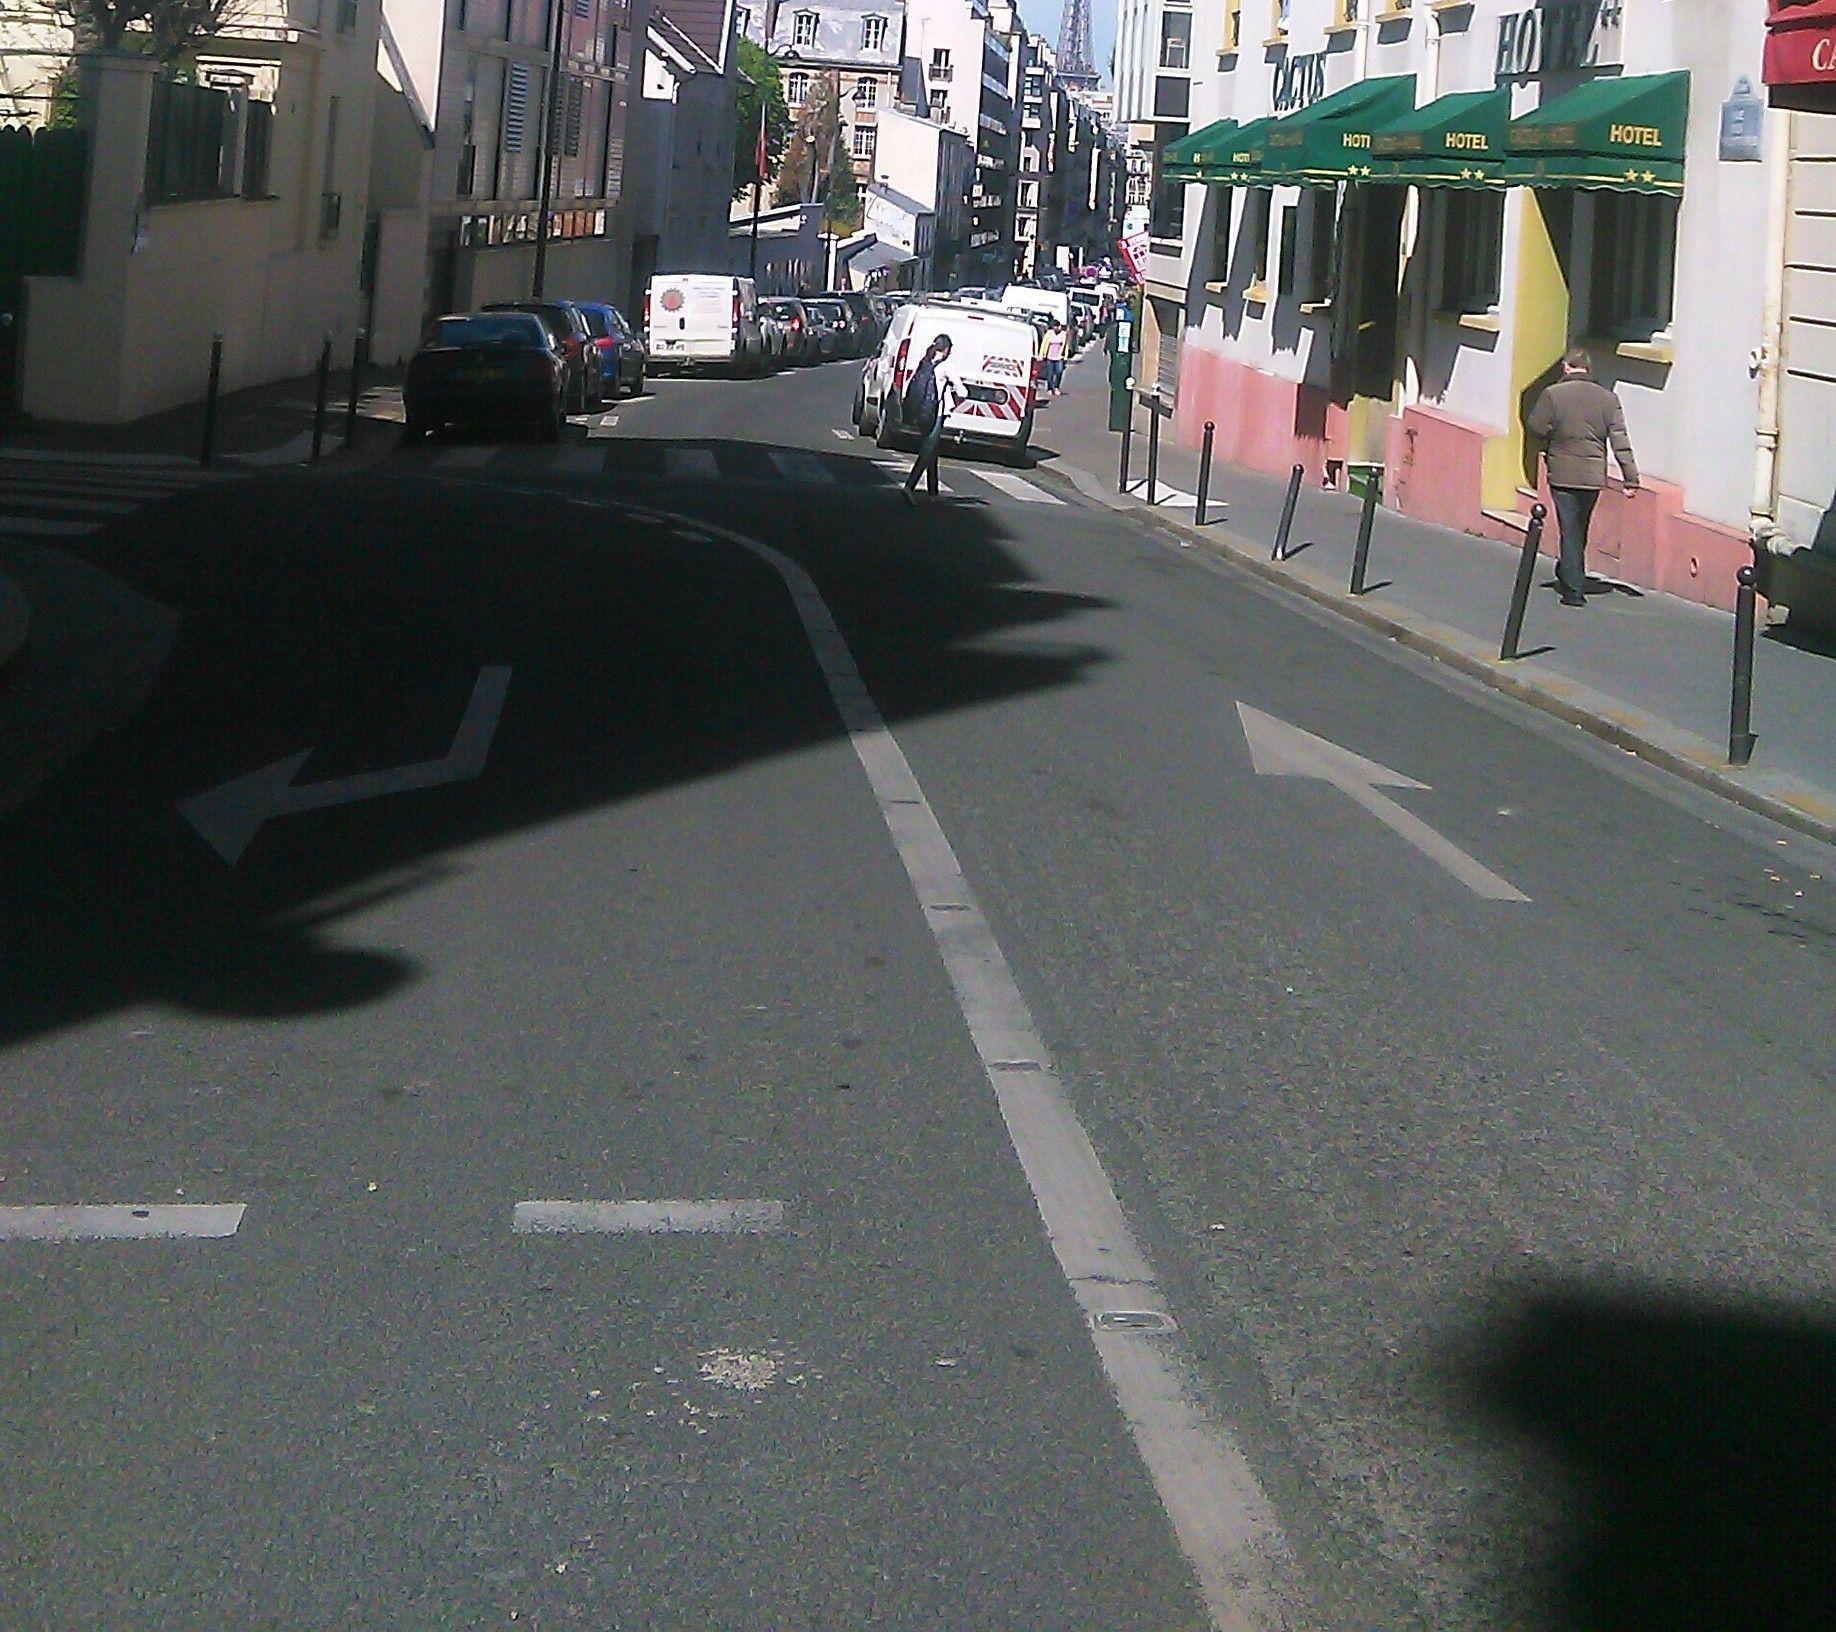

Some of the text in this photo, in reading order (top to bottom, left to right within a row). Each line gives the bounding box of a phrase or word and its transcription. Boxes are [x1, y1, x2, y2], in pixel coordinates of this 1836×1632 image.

[1343, 132, 1371, 148] HOT
[1445, 132, 1489, 150] HOTEL
[1610, 123, 1662, 146] HOTEL
